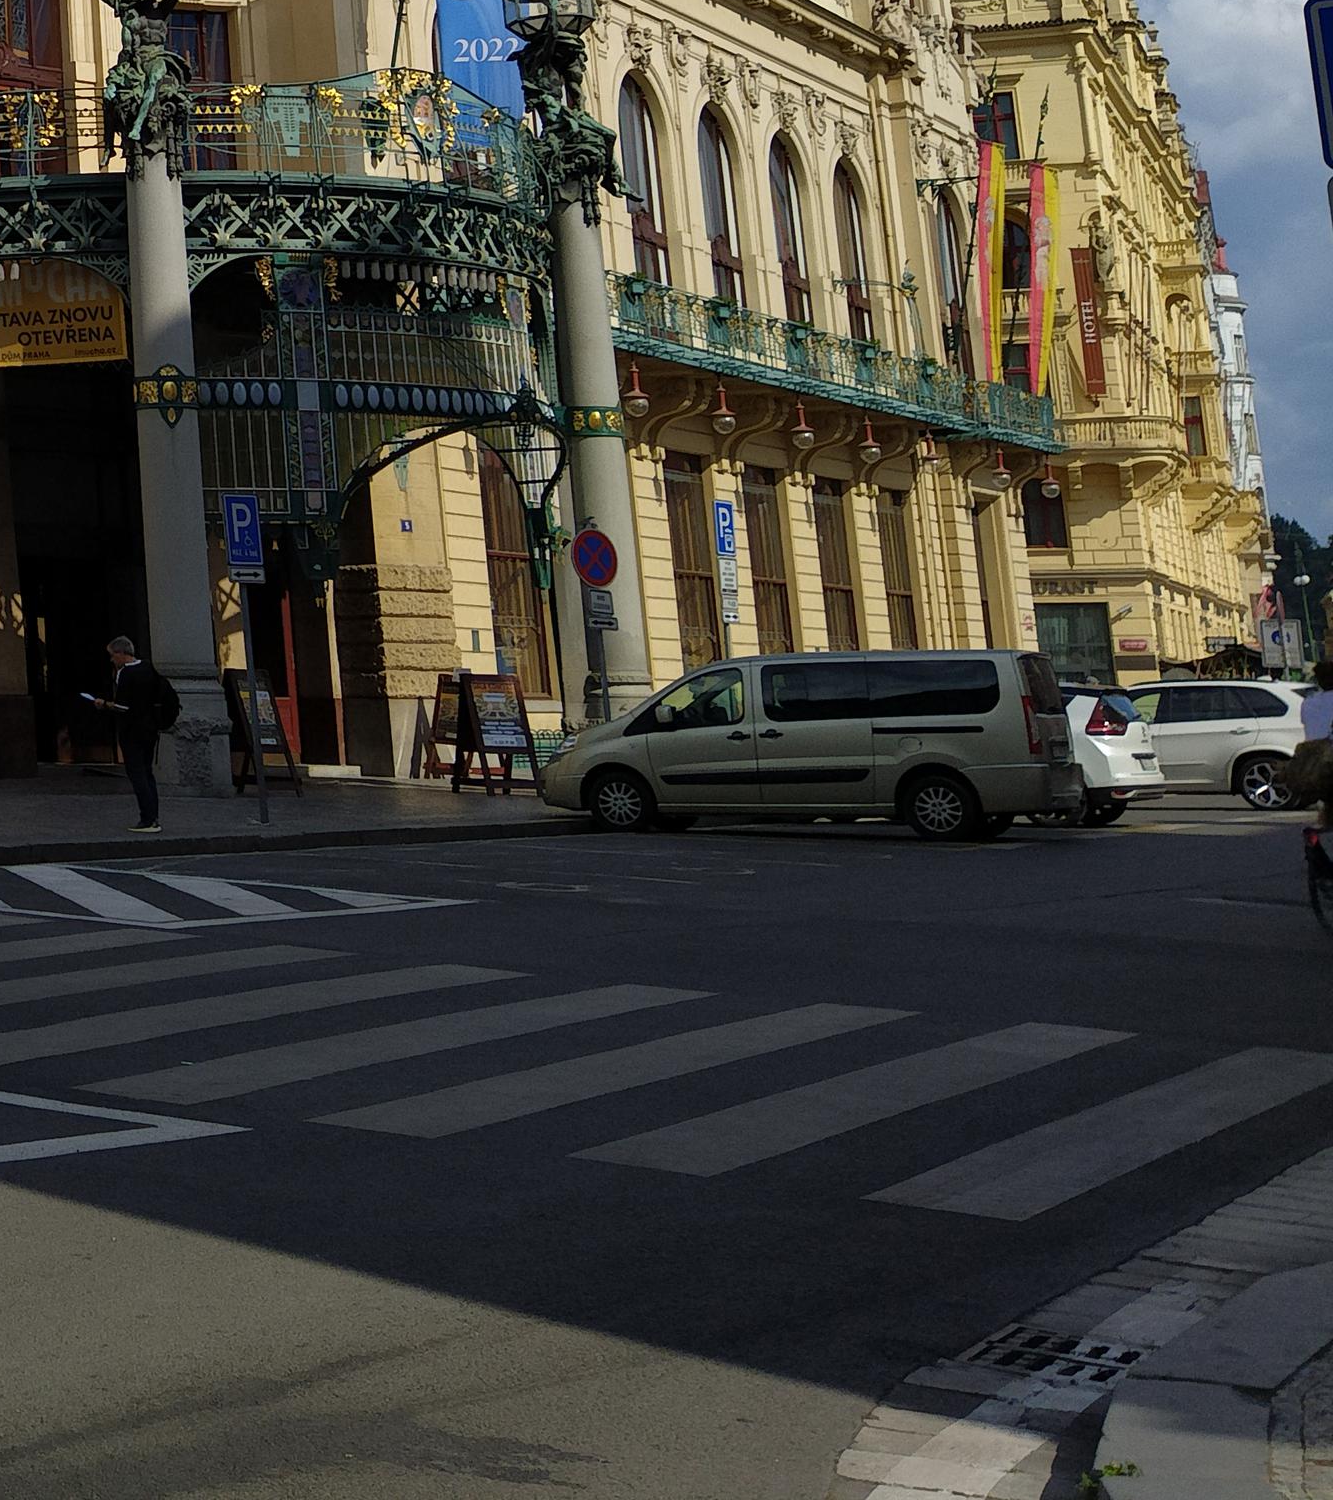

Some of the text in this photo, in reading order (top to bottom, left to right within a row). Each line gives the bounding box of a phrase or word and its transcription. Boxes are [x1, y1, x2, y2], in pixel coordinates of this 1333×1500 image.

[453, 37, 519, 63] 2022
[48, 305, 114, 324] ZNOVU
[1081, 297, 1098, 344] HOTEL
[17, 325, 116, 346] OTEVŘENA
[23, 350, 51, 359] PRAHA
[231, 502, 252, 543] P
[718, 507, 730, 538] P
